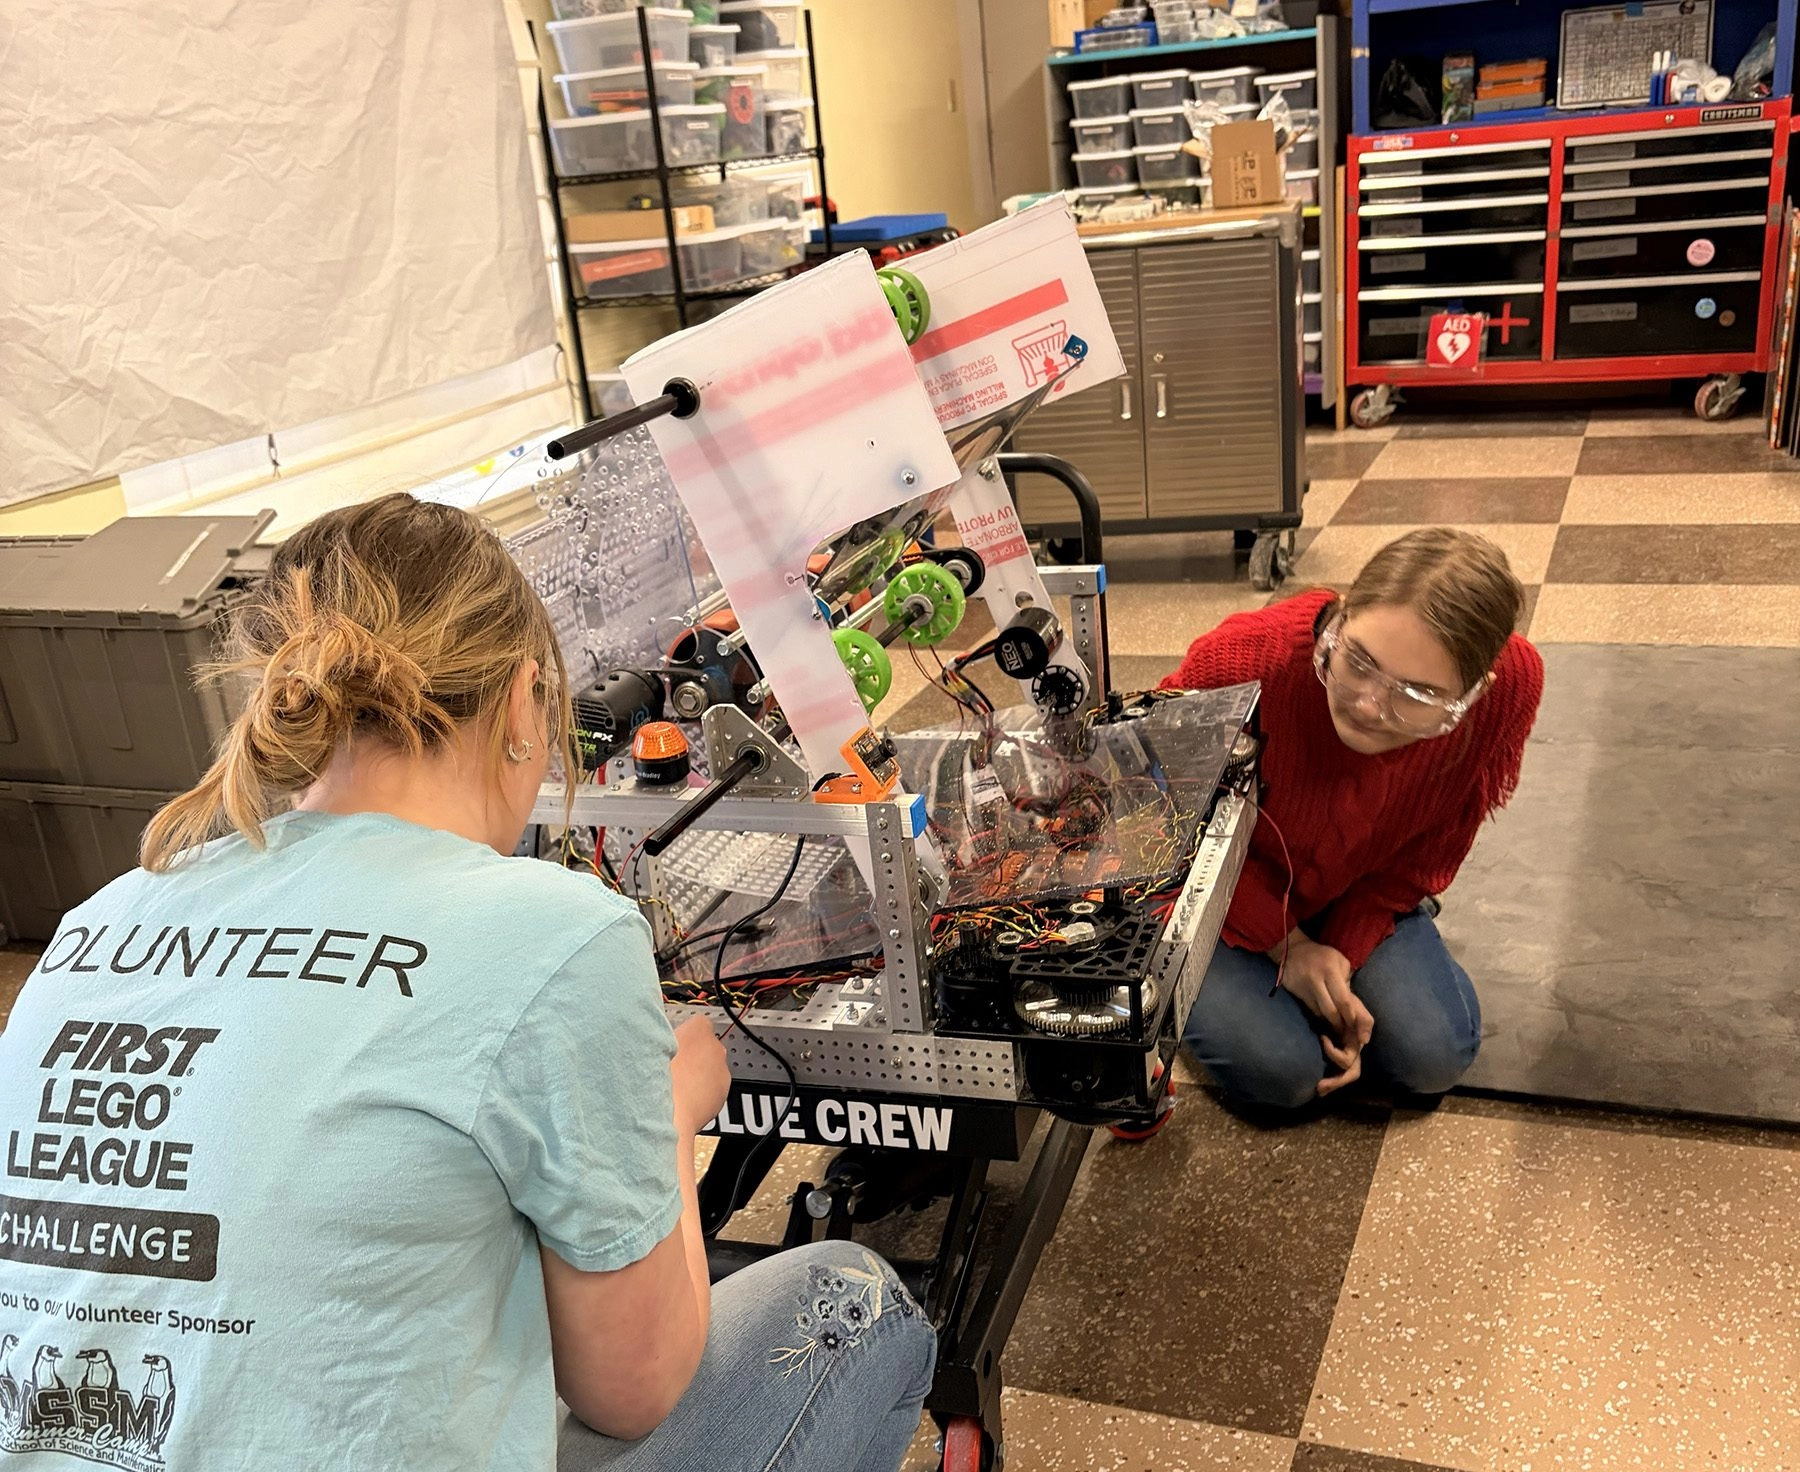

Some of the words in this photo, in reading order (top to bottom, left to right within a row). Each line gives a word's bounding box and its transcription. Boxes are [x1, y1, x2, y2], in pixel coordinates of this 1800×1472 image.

[1442, 318, 1471, 332] AED
[962, 363, 998, 383] ESPECIAL
[939, 378, 963, 393] PLACA
[974, 382, 1005, 399] MILLING
[965, 402, 977, 413] PC
[976, 390, 1008, 408] SPECIAL
[997, 505, 1013, 521] UV
[965, 521, 1018, 548] ARBONATE
[1001, 642, 1021, 671] NEO
[592, 731, 613, 743] FX
[40, 924, 428, 998] OLUNTEER
[815, 1098, 953, 1151] CREW
[7, 1130, 193, 1191] LEAGUE
[0, 1211, 193, 1263] CHALLENGE
[0, 1292, 18, 1308] ou
[23, 1293, 39, 1311] to
[44, 1299, 64, 1316] our
[65, 1302, 163, 1325] Volunteer
[167, 1309, 256, 1335] Sponsor
[5, 1437, 42, 1450] School
[44, 1438, 57, 1449] of
[59, 1440, 95, 1457] Science
[95, 1449, 114, 1462] and
